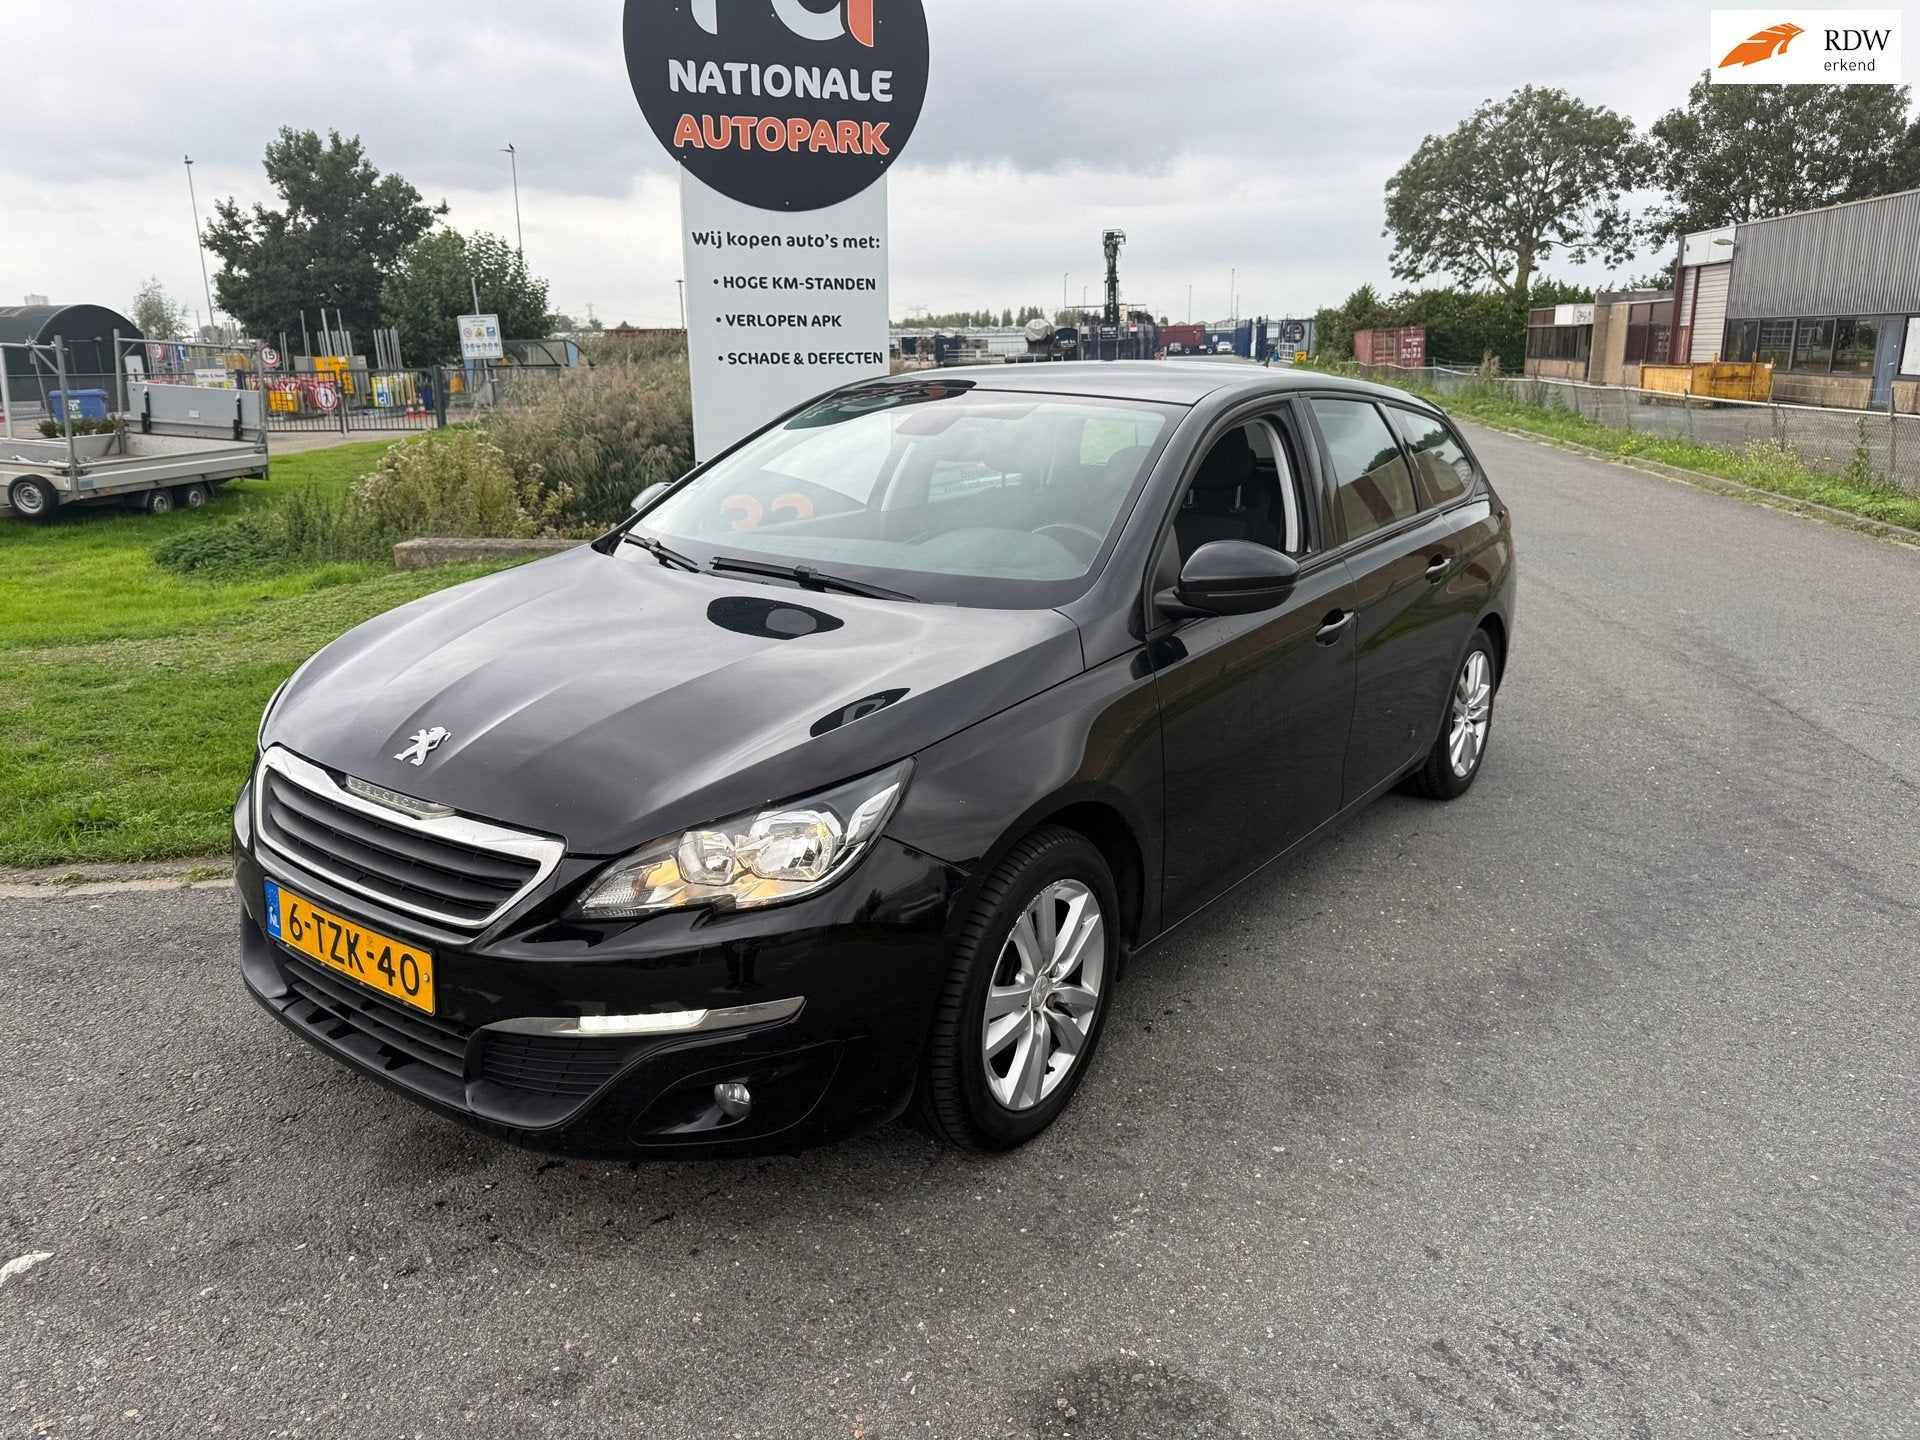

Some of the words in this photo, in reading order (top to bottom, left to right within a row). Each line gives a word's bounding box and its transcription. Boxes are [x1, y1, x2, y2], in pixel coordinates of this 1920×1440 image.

[668, 59, 893, 102] NATIONALE
[673, 113, 890, 155] AUTOPARK
[691, 230, 722, 249] Wij
[726, 231, 782, 250] kopen
[786, 234, 839, 248] auto's
[842, 235, 881, 249] met:
[723, 276, 768, 290] HOGE
[772, 277, 877, 291] KM-STANDEN
[725, 314, 808, 328] VERLOPEN
[811, 315, 842, 328] APK
[264, 350, 275, 360] 15
[728, 352, 791, 365] SCHADE
[793, 352, 804, 365] &
[807, 352, 884, 365] DEFECTEN
[288, 902, 421, 997] 6-TZK-40
